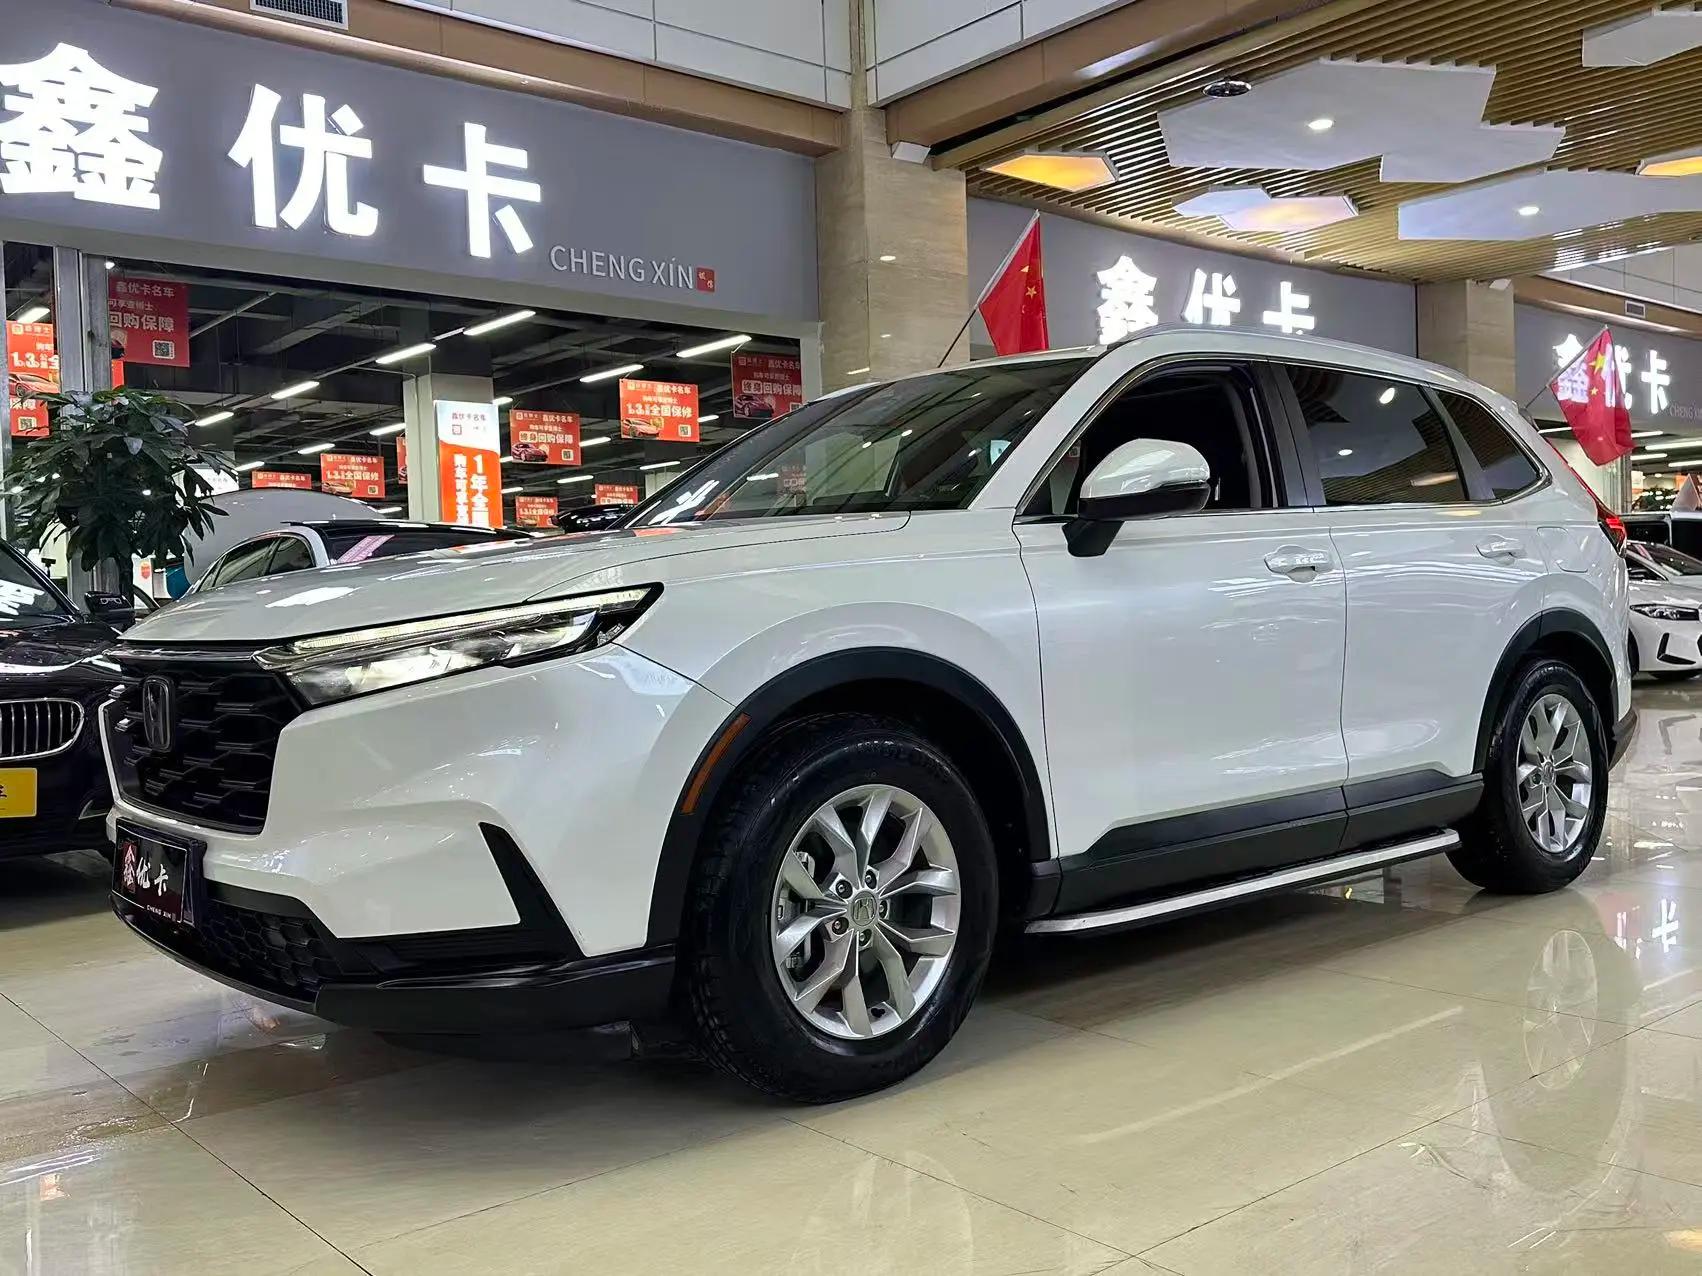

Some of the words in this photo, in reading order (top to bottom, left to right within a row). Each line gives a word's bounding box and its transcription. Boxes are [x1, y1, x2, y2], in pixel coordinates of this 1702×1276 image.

[0, 42, 541, 258] 鑫优卡
[550, 245, 645, 282] CHENG
[116, 281, 175, 298] 鑫优卡名车
[109, 311, 174, 333] 回购保障
